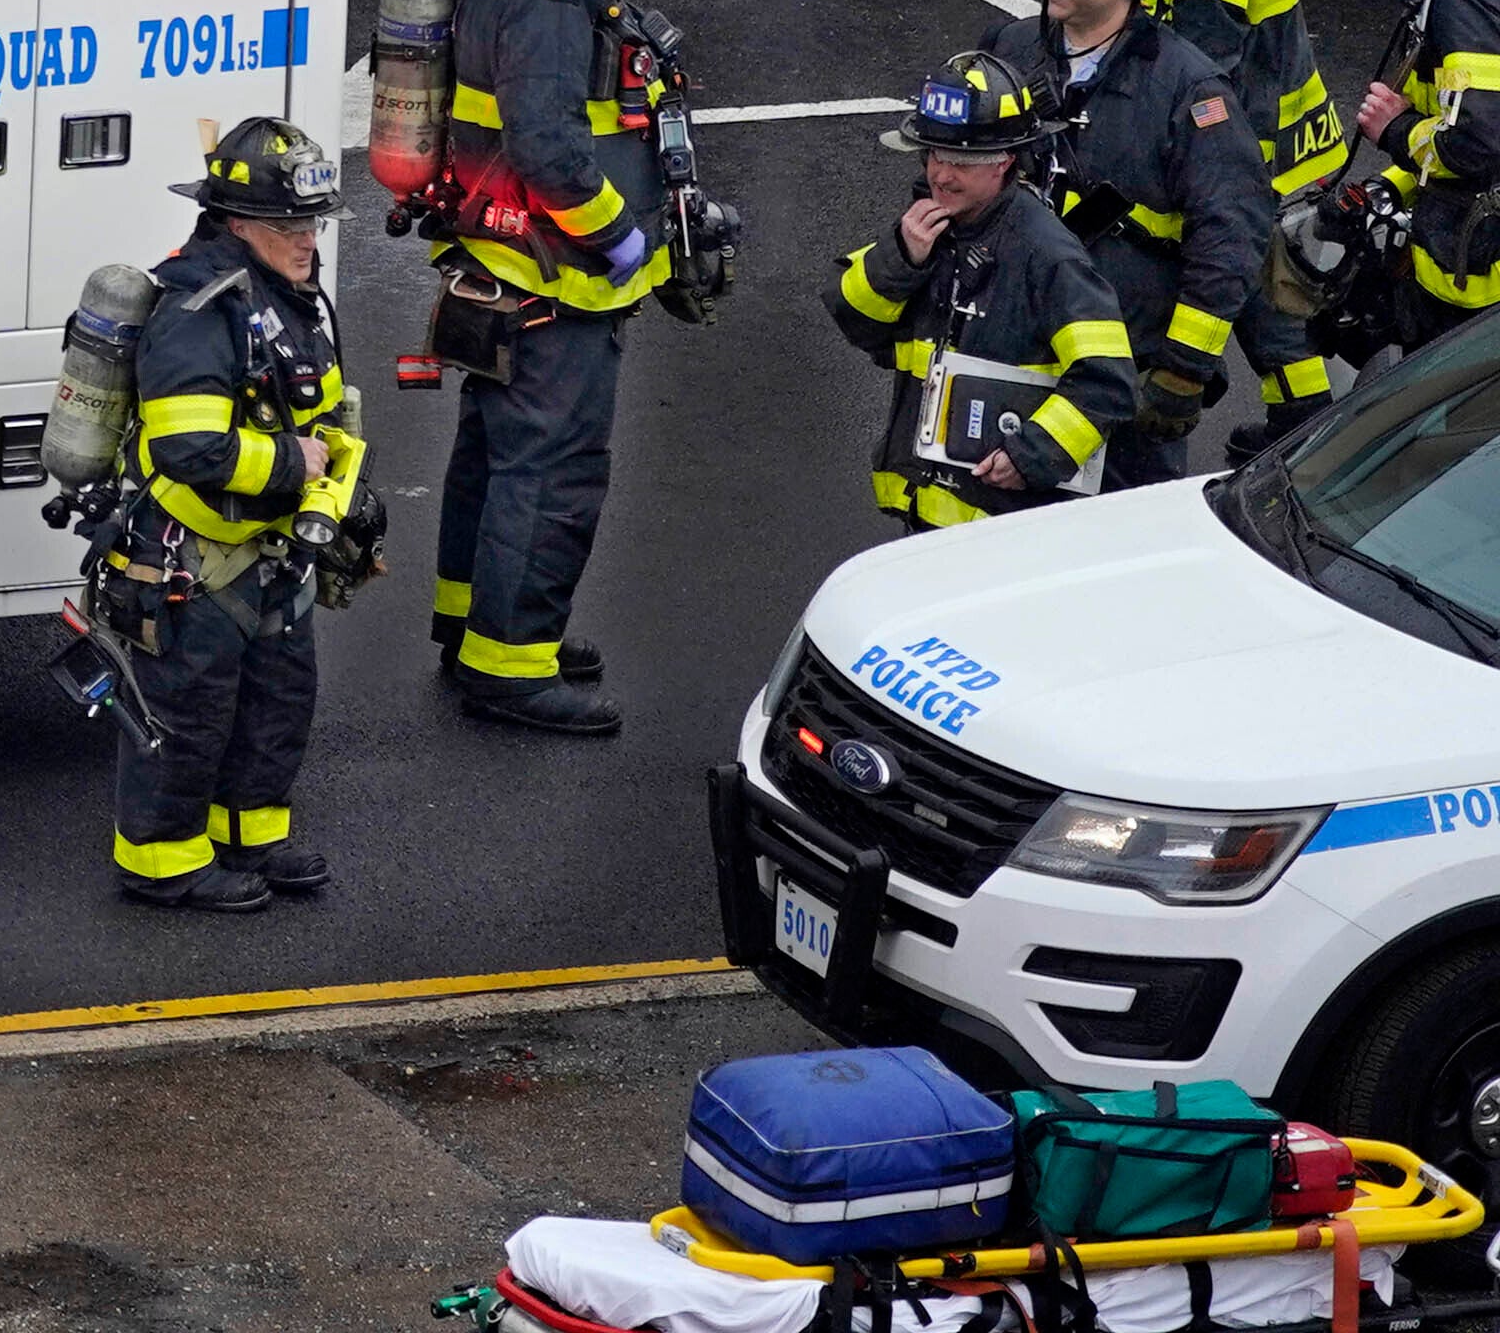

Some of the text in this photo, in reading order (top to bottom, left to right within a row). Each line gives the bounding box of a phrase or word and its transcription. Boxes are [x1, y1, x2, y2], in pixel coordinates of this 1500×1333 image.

[850, 645, 981, 736] POLICE
[902, 636, 1001, 692] NYPD
[838, 747, 872, 780] Ford
[783, 900, 830, 958] 5010
